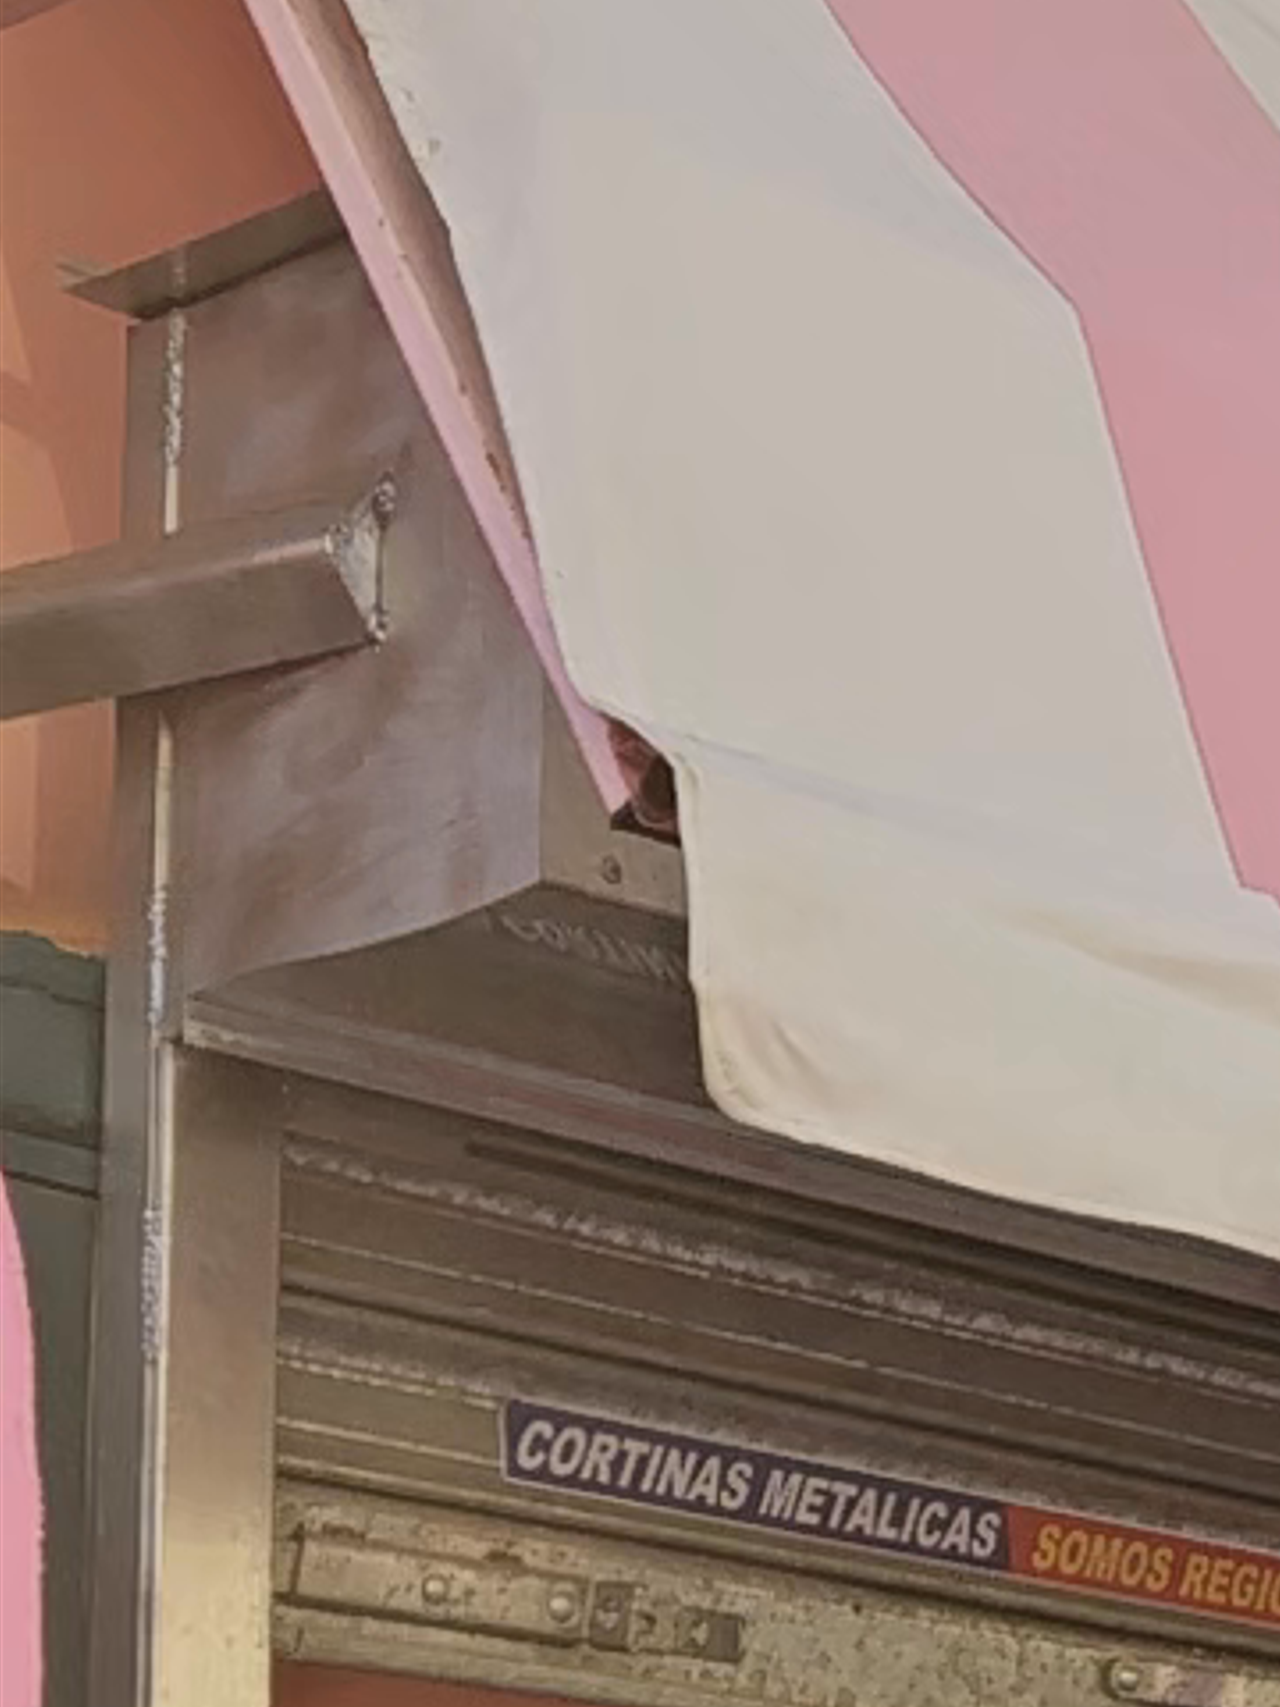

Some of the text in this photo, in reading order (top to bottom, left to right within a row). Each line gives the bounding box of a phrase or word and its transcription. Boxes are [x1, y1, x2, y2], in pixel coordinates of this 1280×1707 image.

[515, 1419, 755, 1513] CORTINAS
[758, 1468, 1001, 1560] METALICAS
[1031, 1523, 1174, 1593] SOMOS
